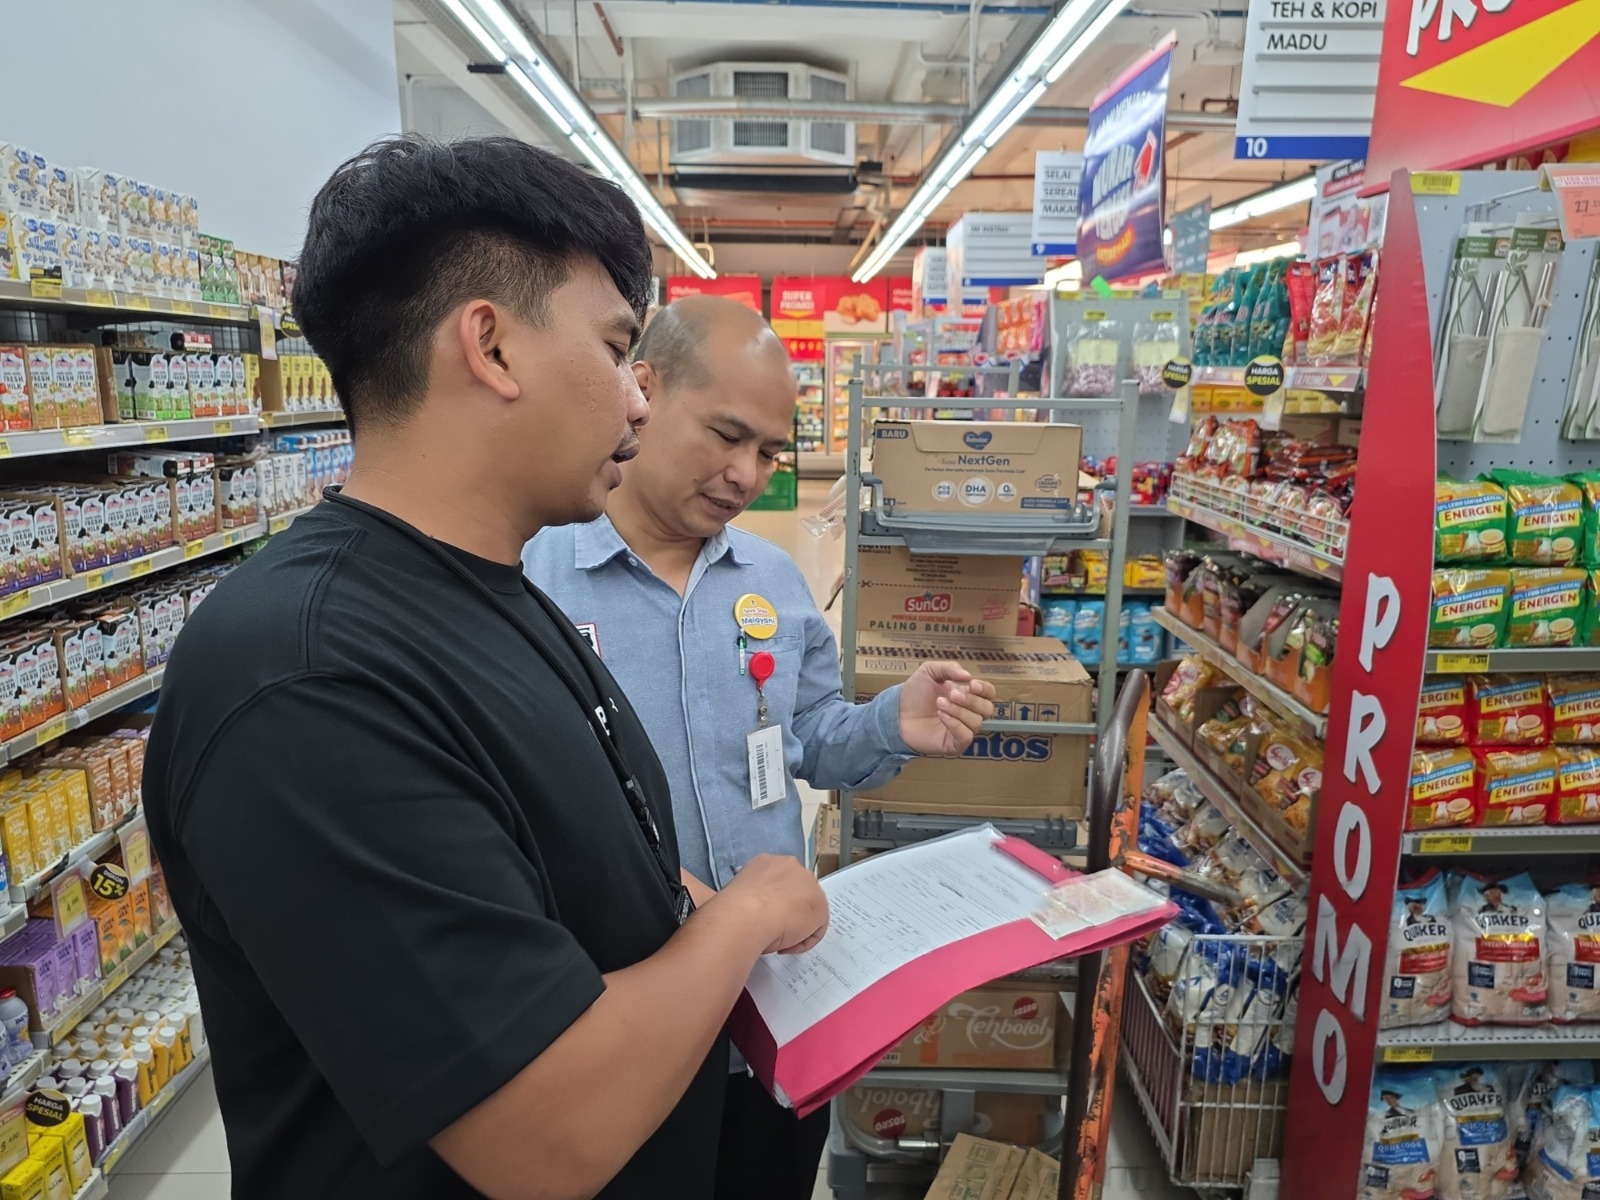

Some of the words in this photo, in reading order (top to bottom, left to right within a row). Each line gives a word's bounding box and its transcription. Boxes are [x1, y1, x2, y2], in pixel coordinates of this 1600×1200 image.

[1271, 2, 1304, 18] TEH
[1311, 2, 1327, 18] &
[1331, 2, 1377, 19] KOPI
[1267, 33, 1327, 50] MADU
[1246, 138, 1268, 158] 10
[1045, 170, 1071, 179] SELAI
[1044, 187, 1078, 196] SEREAL
[782, 291, 812, 301] SUPER
[1163, 371, 1188, 382] SPESIAL
[1167, 365, 1189, 374] HARGA
[1251, 367, 1279, 376] HARGA
[1246, 376, 1281, 386] SPESIAL
[881, 429, 906, 438] BARU
[957, 455, 1011, 467] NextGen
[965, 484, 987, 493] DHA
[1444, 503, 1502, 522] ENERGEN
[1523, 512, 1576, 527] ENERGEN
[908, 597, 949, 612] SunCo
[1442, 598, 1499, 617] ENERGEN
[1518, 593, 1577, 611] ENERGEN
[741, 616, 776, 627] Melayani
[892, 614, 918, 622] MINYAK
[918, 615, 946, 623] GORENG
[870, 620, 918, 631] PALING
[925, 624, 985, 635] BENING!!
[1486, 690, 1538, 708] ENERGEN
[998, 707, 1005, 716] 8
[967, 732, 1051, 759] ntos
[1418, 774, 1470, 794] ENERGEN
[1495, 781, 1549, 798] ENERGEN
[1313, 572, 1401, 1106] PROMO
[93, 873, 125, 897] 15%
[103, 870, 125, 885] DISKON
[1476, 914, 1529, 929] QUAKER
[1578, 913, 1600, 930] QUA
[1403, 923, 1447, 942] QUAKER
[1014, 1002, 1037, 1017] SOSRO
[947, 1002, 1053, 1050] Tehbotol
[33, 1096, 64, 1111] HARGA
[26, 1103, 64, 1122] SPESIAL
[875, 1114, 906, 1132] SOSRO
